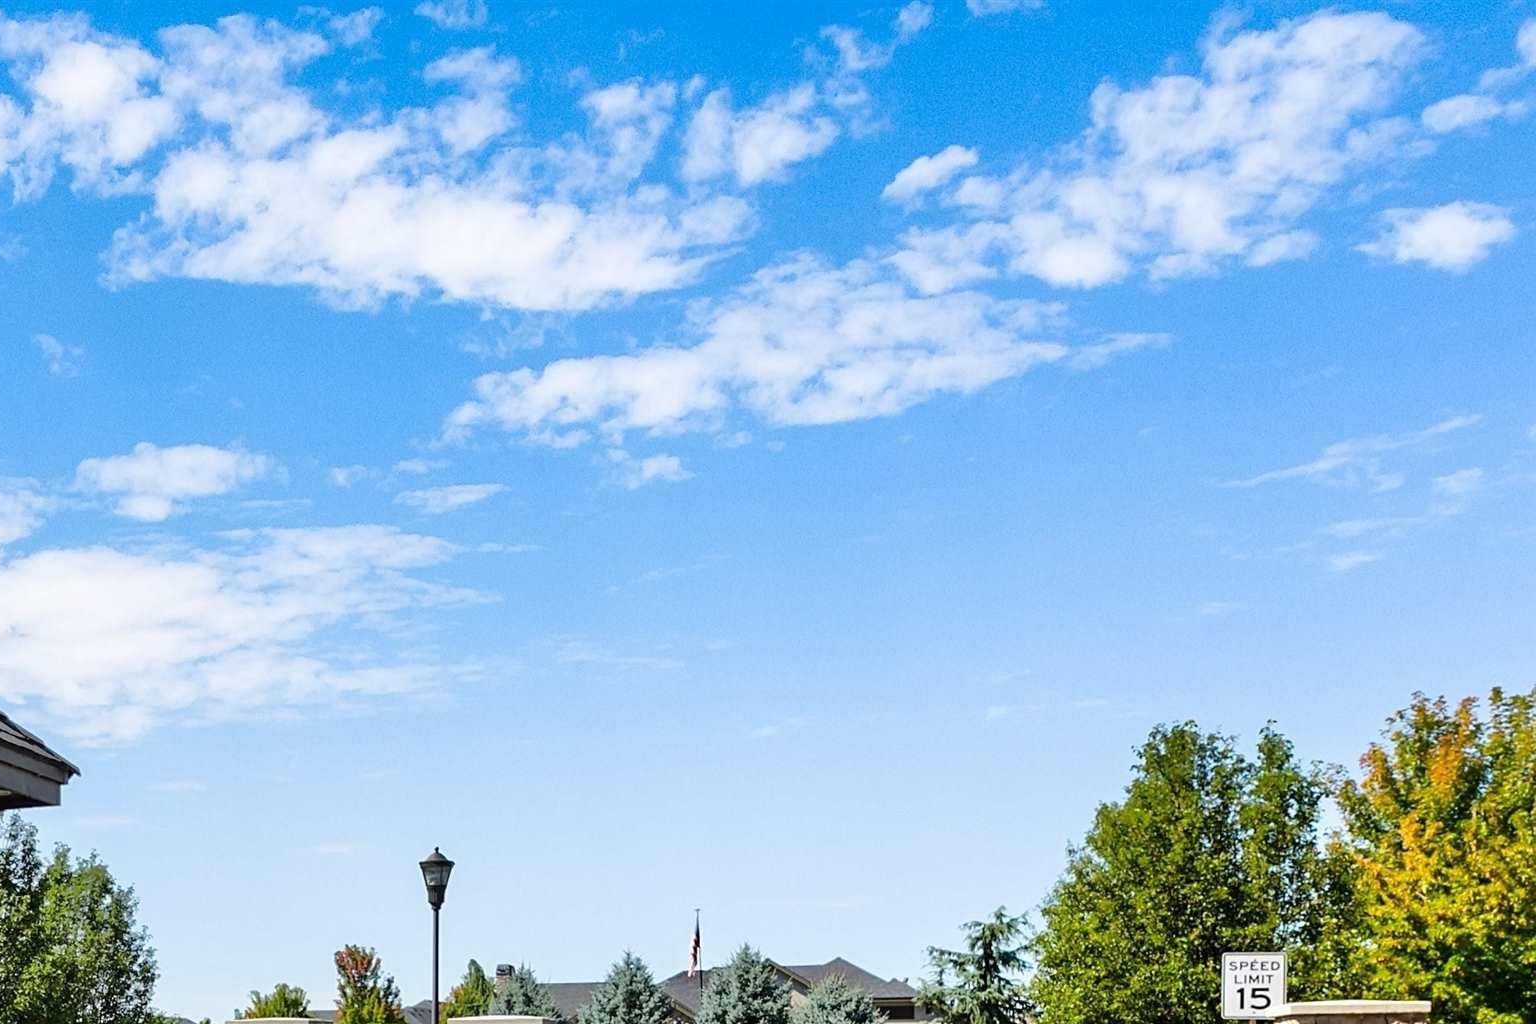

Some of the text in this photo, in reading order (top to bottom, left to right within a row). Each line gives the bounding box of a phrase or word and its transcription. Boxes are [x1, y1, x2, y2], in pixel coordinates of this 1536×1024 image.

[1229, 961, 1281, 971] SPEED
[1234, 974, 1274, 984] LIMIT
[1236, 987, 1271, 1010] 15
